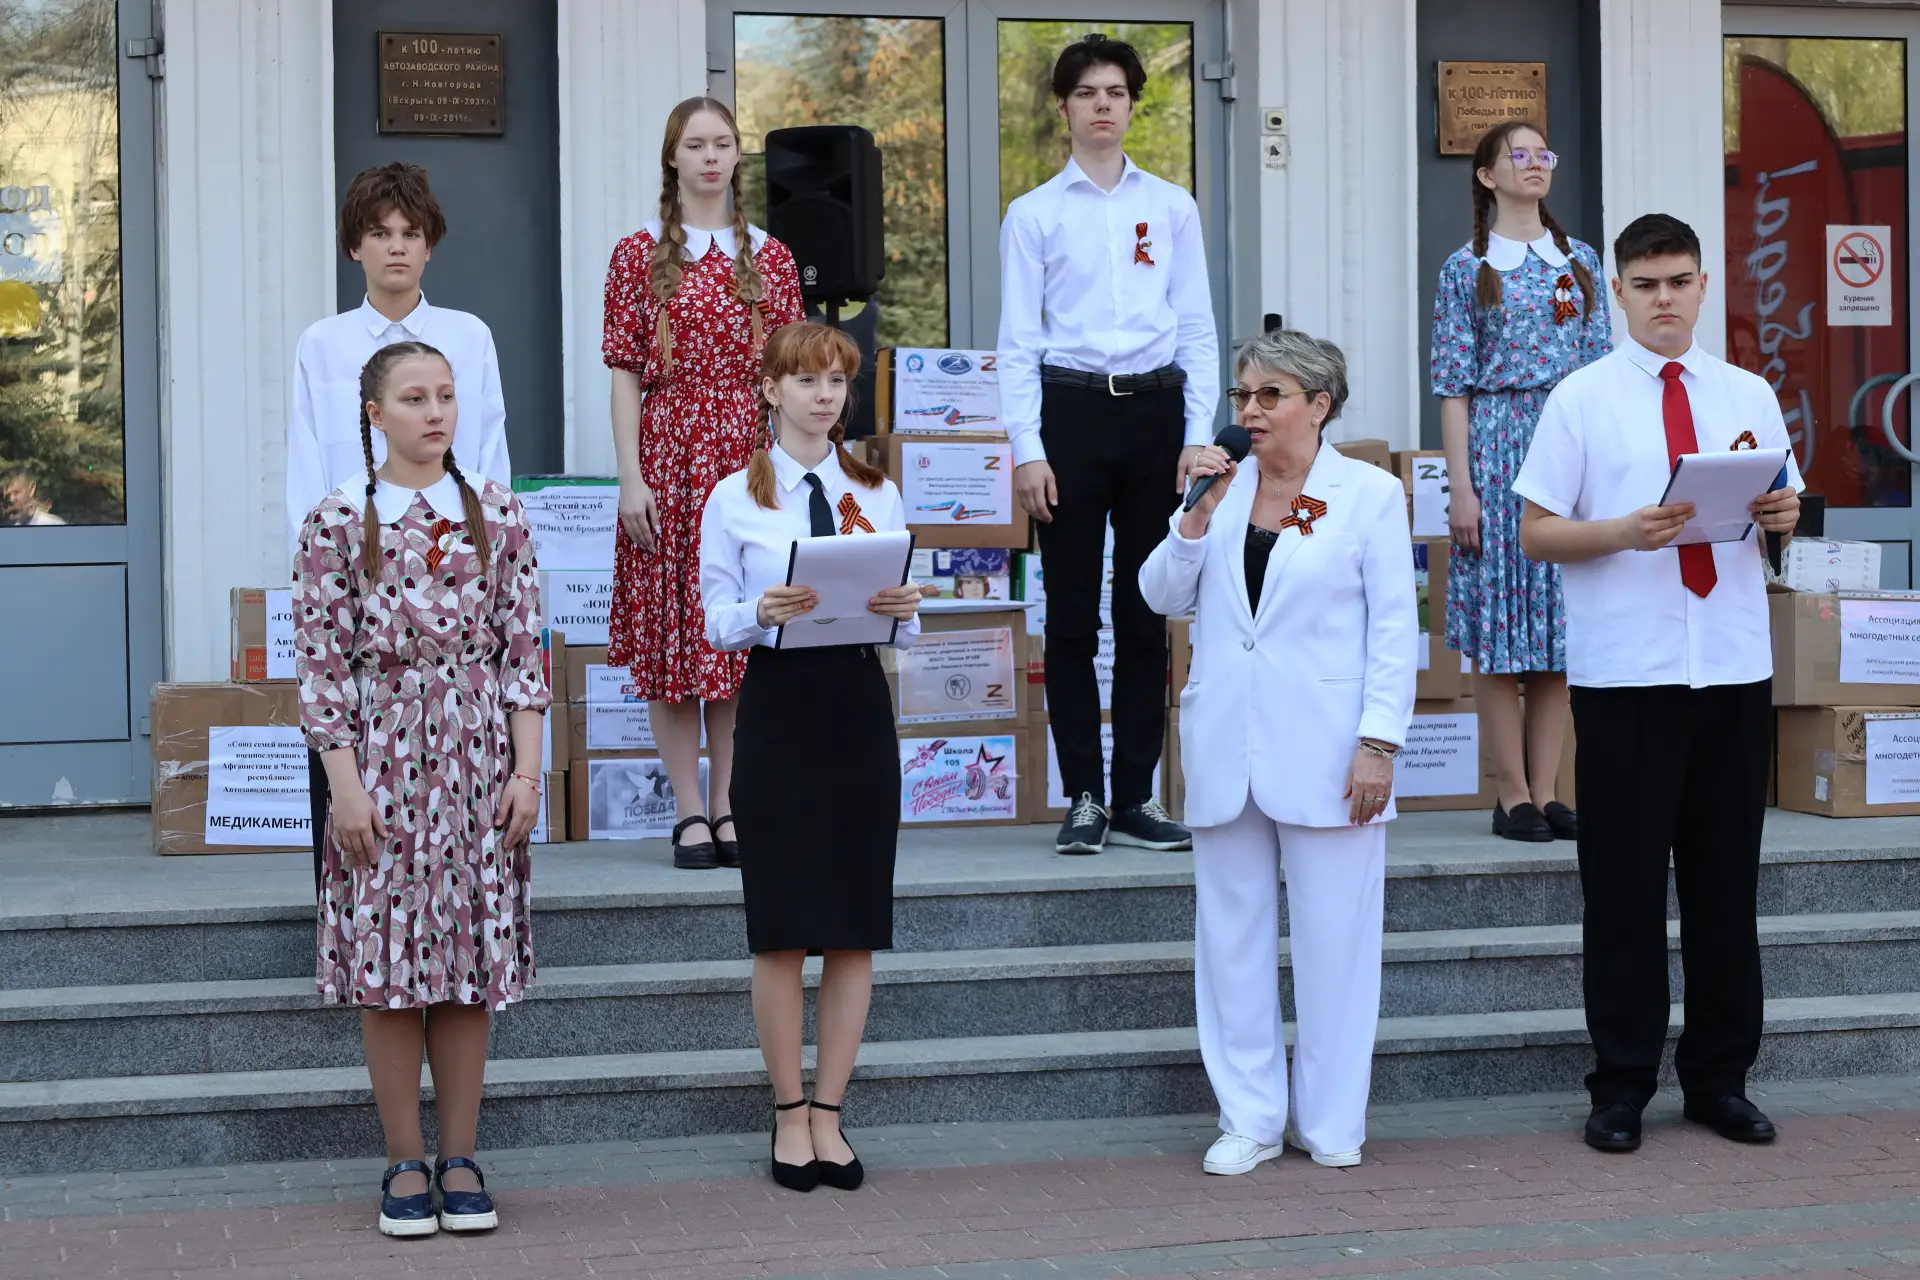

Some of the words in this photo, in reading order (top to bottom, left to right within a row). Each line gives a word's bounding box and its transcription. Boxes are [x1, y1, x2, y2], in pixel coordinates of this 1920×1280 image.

[384, 62, 460, 72] АВТОЗАВОДСКОГО
[465, 61, 499, 72] РАЙОНА
[1457, 106, 1498, 117] Победы
[1507, 107, 1529, 116] ВОВ
[1843, 294, 1875, 303] Курение
[542, 502, 579, 511] Детский
[582, 502, 603, 511] клуб
[554, 513, 591, 521] «Атлет»
[576, 524, 615, 533] бросаем!
[566, 584, 592, 593] МБУ
[595, 584, 613, 594] ДО
[1868, 615, 1920, 627] Ассоциация
[1849, 632, 1910, 642] многодетных
[1442, 735, 1472, 743] района
[228, 740, 253, 748] «Союз
[944, 747, 974, 755] Школа
[1420, 747, 1458, 756] Нижнего
[222, 763, 272, 771] Афганистане
[1404, 760, 1446, 769] Новгорода
[248, 774, 295, 782] республике»
[223, 786, 280, 794] Автозаводское
[624, 800, 675, 818] ПОБЕДА
[210, 816, 312, 830] МЕДИКАМЕНТ
